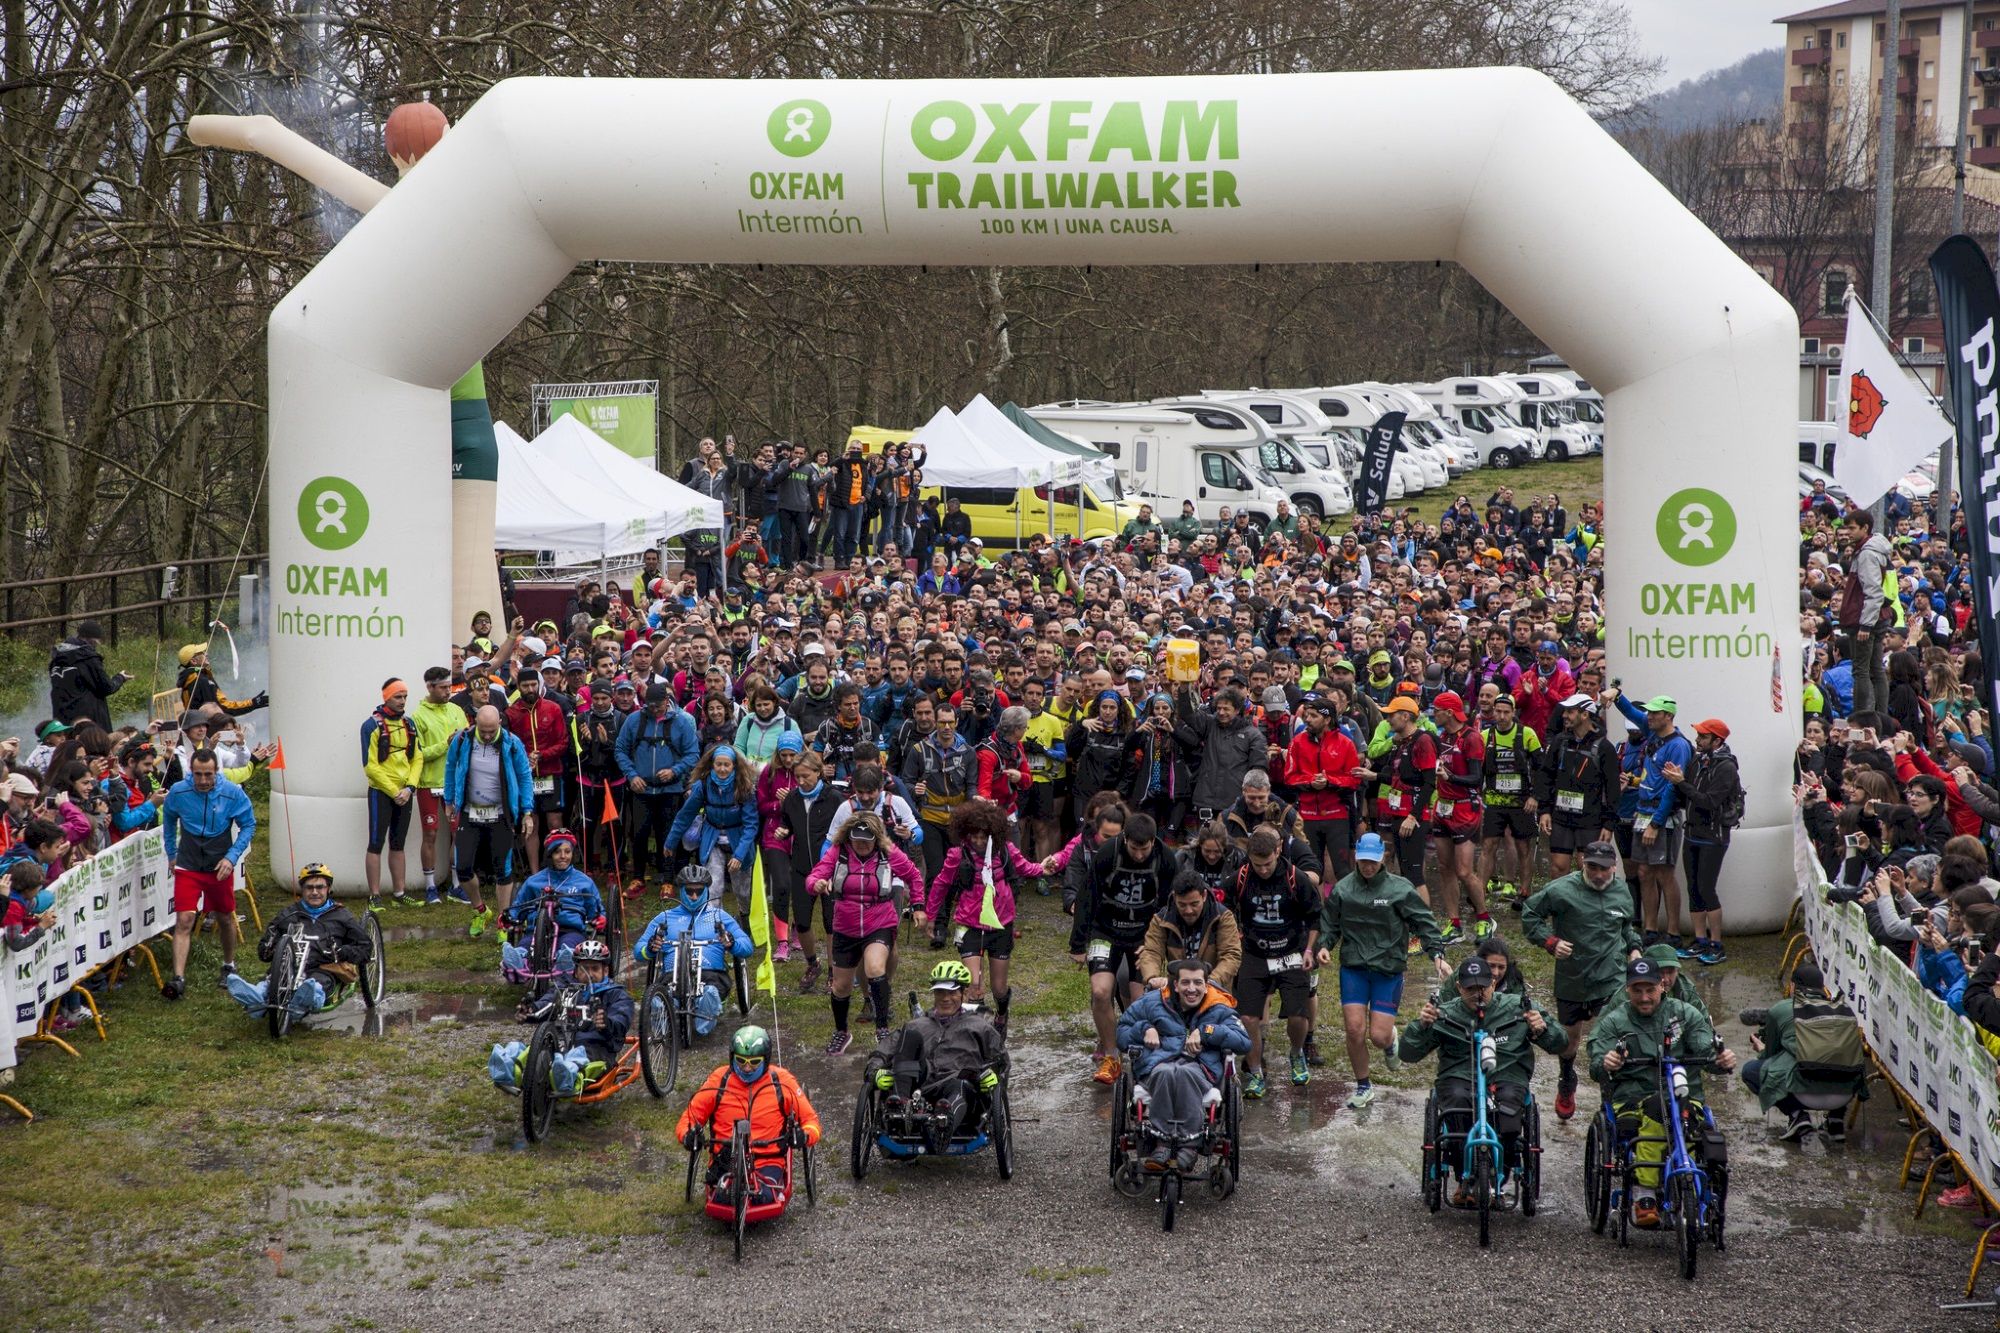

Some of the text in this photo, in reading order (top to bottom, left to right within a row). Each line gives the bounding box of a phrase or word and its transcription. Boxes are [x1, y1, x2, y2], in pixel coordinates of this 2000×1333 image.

[911, 99, 1239, 162] OXFAM
[749, 171, 844, 201] OXFAM
[907, 169, 1242, 209] TRAILWALKER
[738, 207, 863, 235] Intermón
[980, 218, 1174, 234] 100 KM UNA CAUSA
[1369, 427, 1394, 481] Salud
[285, 563, 388, 598] OXFAM
[1640, 582, 1756, 615] OXFAM
[276, 604, 404, 639] Intermón
[1627, 624, 1772, 659] Intermón
[118, 882, 132, 901] DKV
[140, 871, 157, 890] DKV
